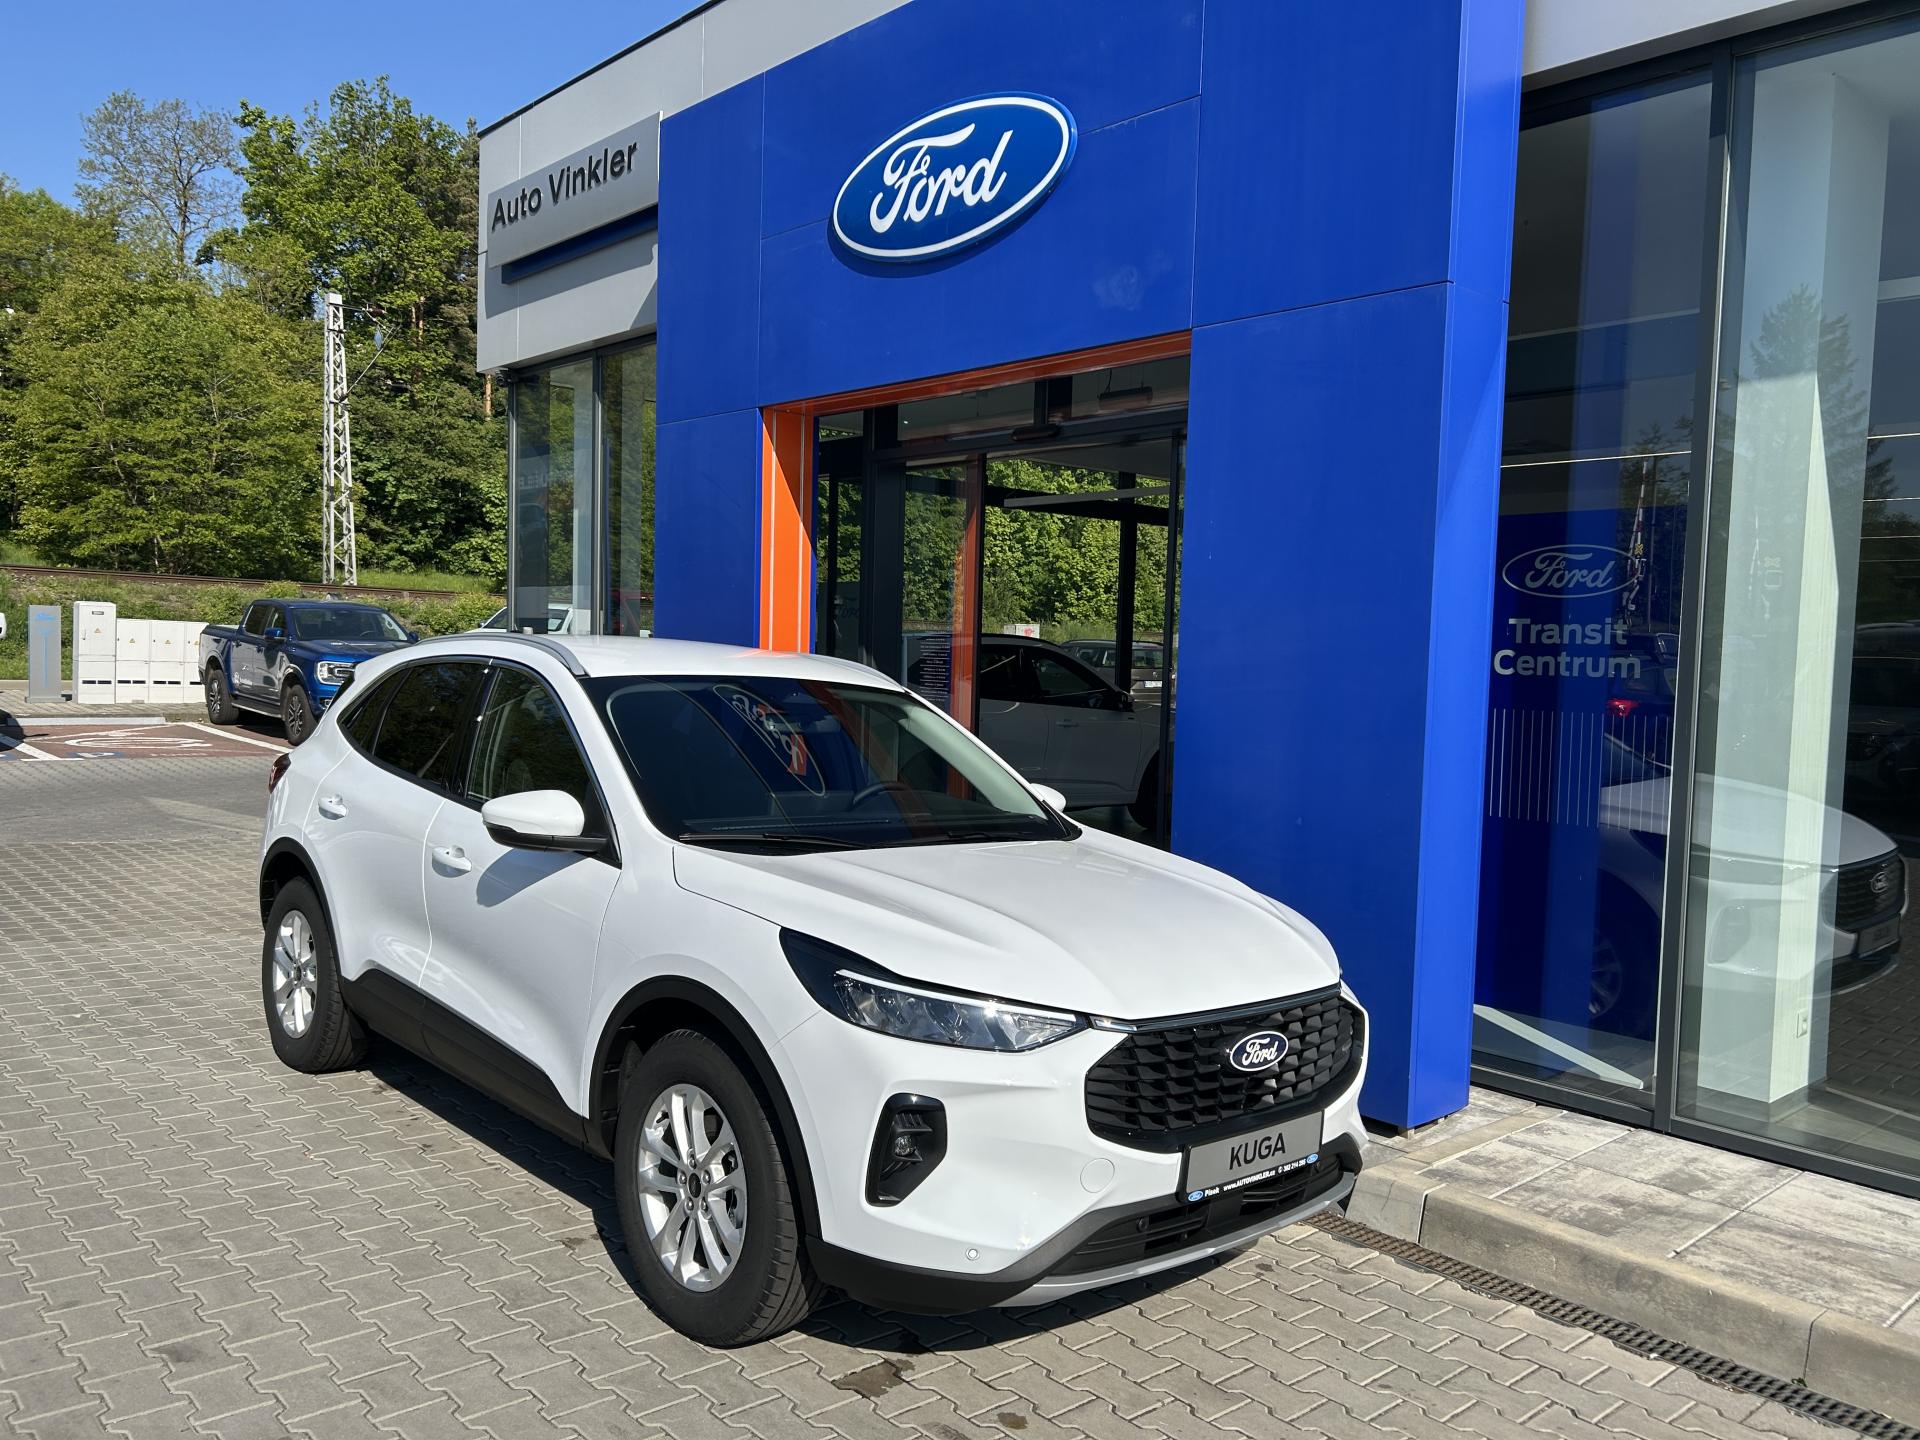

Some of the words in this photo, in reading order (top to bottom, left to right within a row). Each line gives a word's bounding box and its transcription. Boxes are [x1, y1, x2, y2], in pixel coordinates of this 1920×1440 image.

[491, 187, 543, 232] Auto
[548, 140, 638, 206] Vinkler
[869, 122, 1014, 234] Ford
[1524, 552, 1616, 588] Ford
[1508, 617, 1628, 645] Transit
[1493, 649, 1641, 679] Centrum
[1242, 1038, 1279, 1066] Ford
[1228, 1132, 1286, 1171] KUGA
